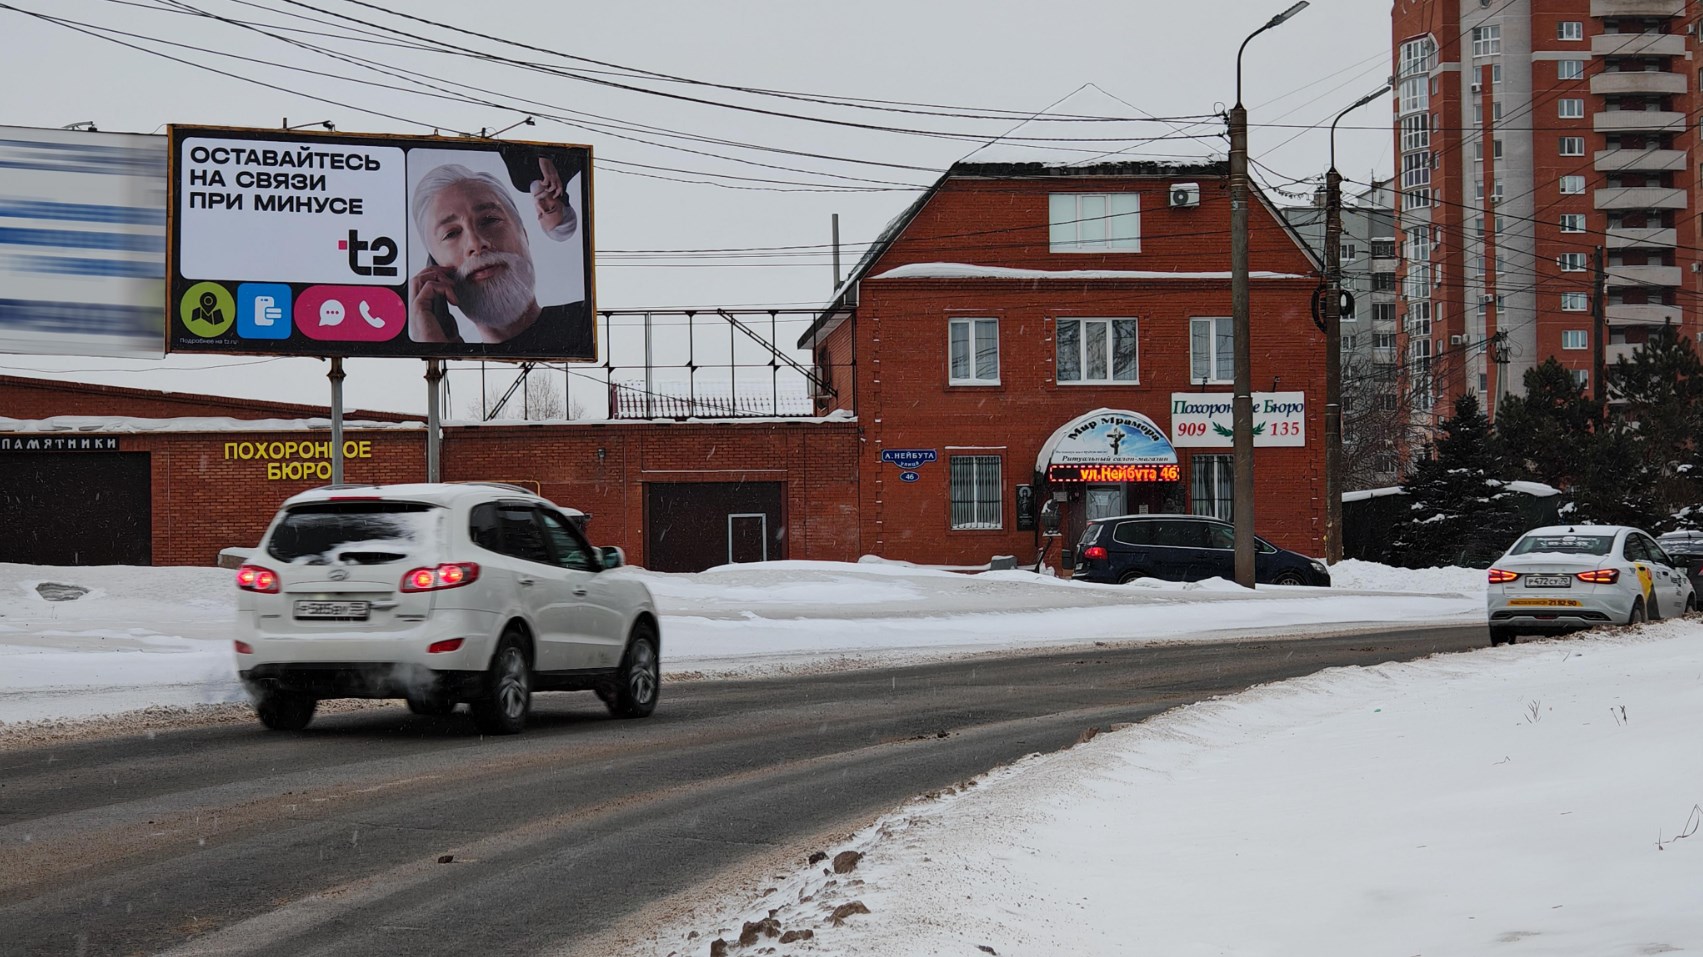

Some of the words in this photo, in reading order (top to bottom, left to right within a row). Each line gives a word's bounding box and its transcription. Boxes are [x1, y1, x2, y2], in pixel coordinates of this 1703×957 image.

[190, 146, 381, 171] ОСТАВАЙТЕСЬ
[190, 169, 226, 187] НА
[235, 171, 326, 191] СВЯЗИ
[189, 192, 243, 210] ПРИ
[254, 194, 363, 215] МИНУСЕ
[338, 229, 398, 276] t2
[1263, 399, 1304, 417] Бюро
[1068, 421, 1097, 440] Мир
[1101, 417, 1160, 442] Мрамора
[1178, 422, 1207, 437] 909
[1271, 422, 1300, 436] 135
[1, 438, 116, 449] ПАМЯТНИКИ
[224, 441, 372, 459] ПОХОРОНОЕ
[267, 461, 332, 480] БЮРО
[1161, 467, 1177, 480] 46
